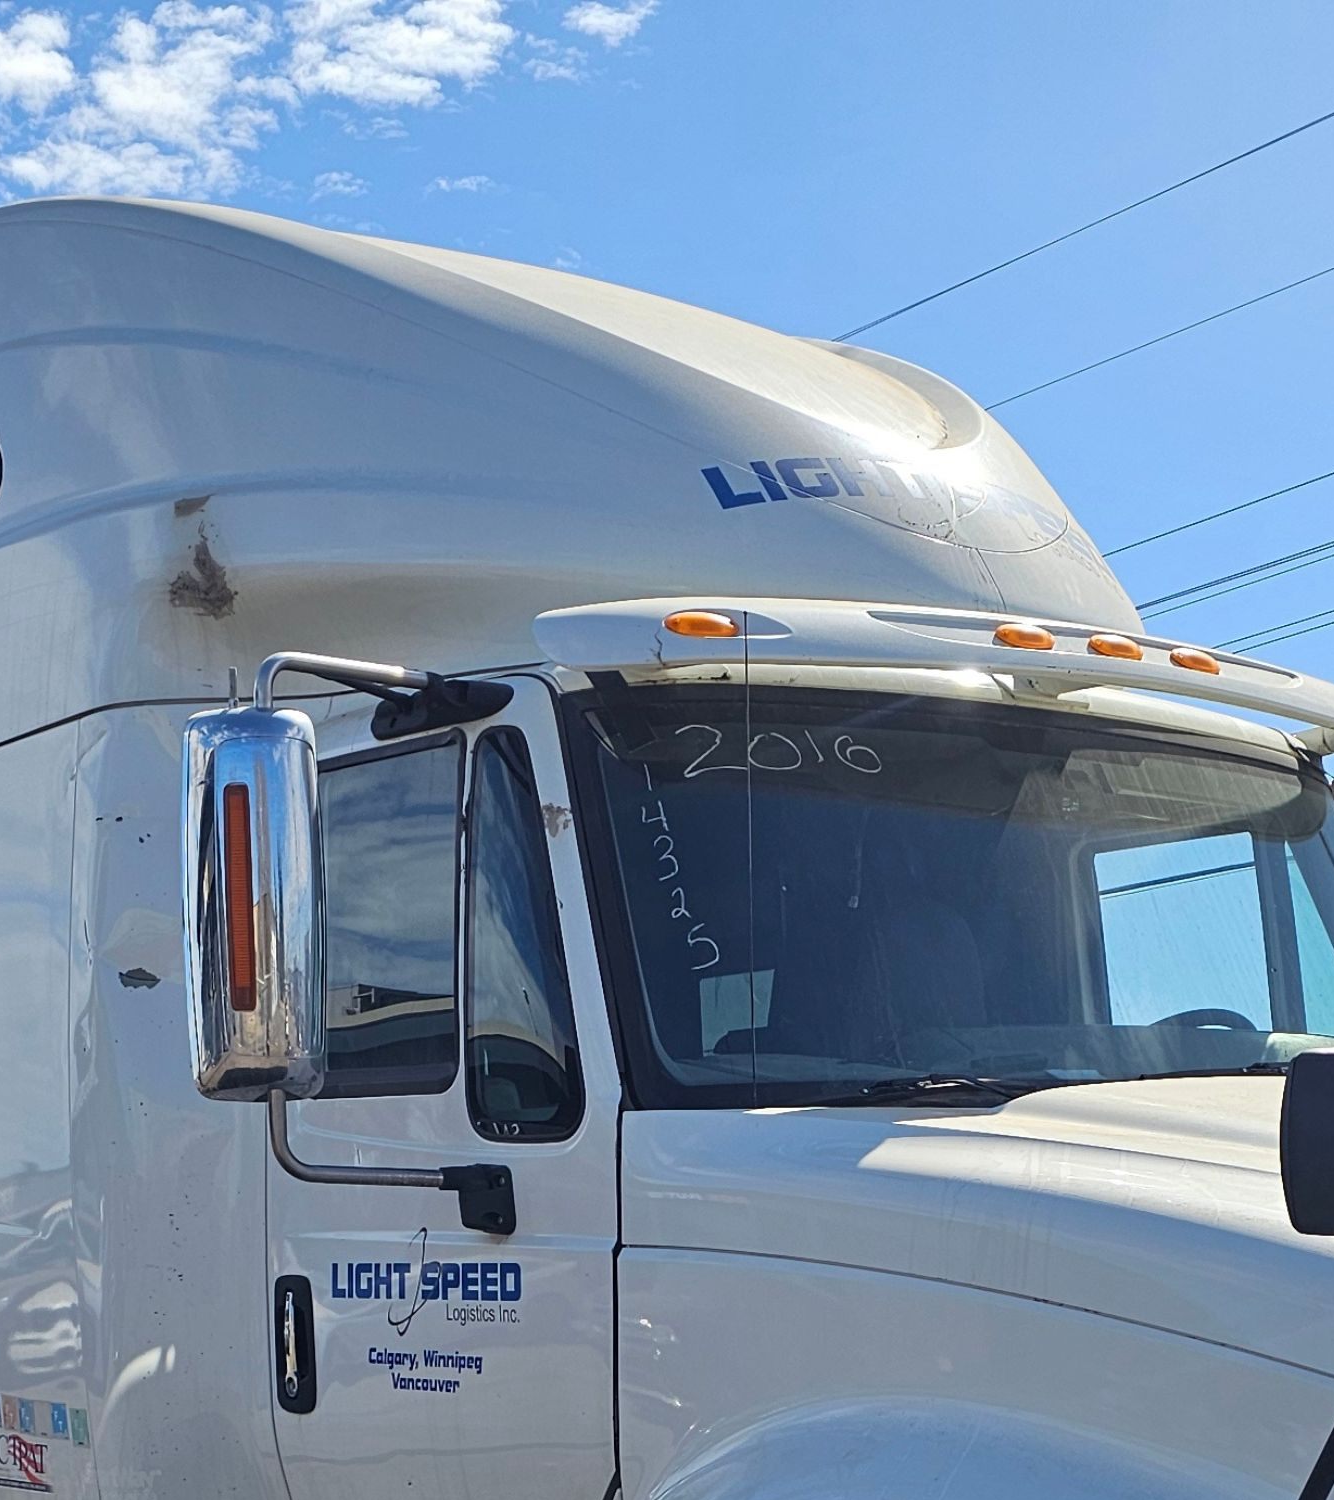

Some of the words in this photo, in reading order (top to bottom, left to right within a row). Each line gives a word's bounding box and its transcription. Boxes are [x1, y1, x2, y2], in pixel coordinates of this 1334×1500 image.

[700, 457, 927, 511] LIGHT
[674, 724, 882, 778] 2016
[640, 763, 720, 970] 14325
[331, 1262, 411, 1300] LIGHT
[421, 1262, 522, 1302] SPEED
[446, 1304, 495, 1326] Logistics
[499, 1304, 521, 1323] Inc.
[368, 1348, 419, 1370] Calgary,
[423, 1350, 483, 1374] Winnipeg
[391, 1373, 460, 1394] Vancouver
